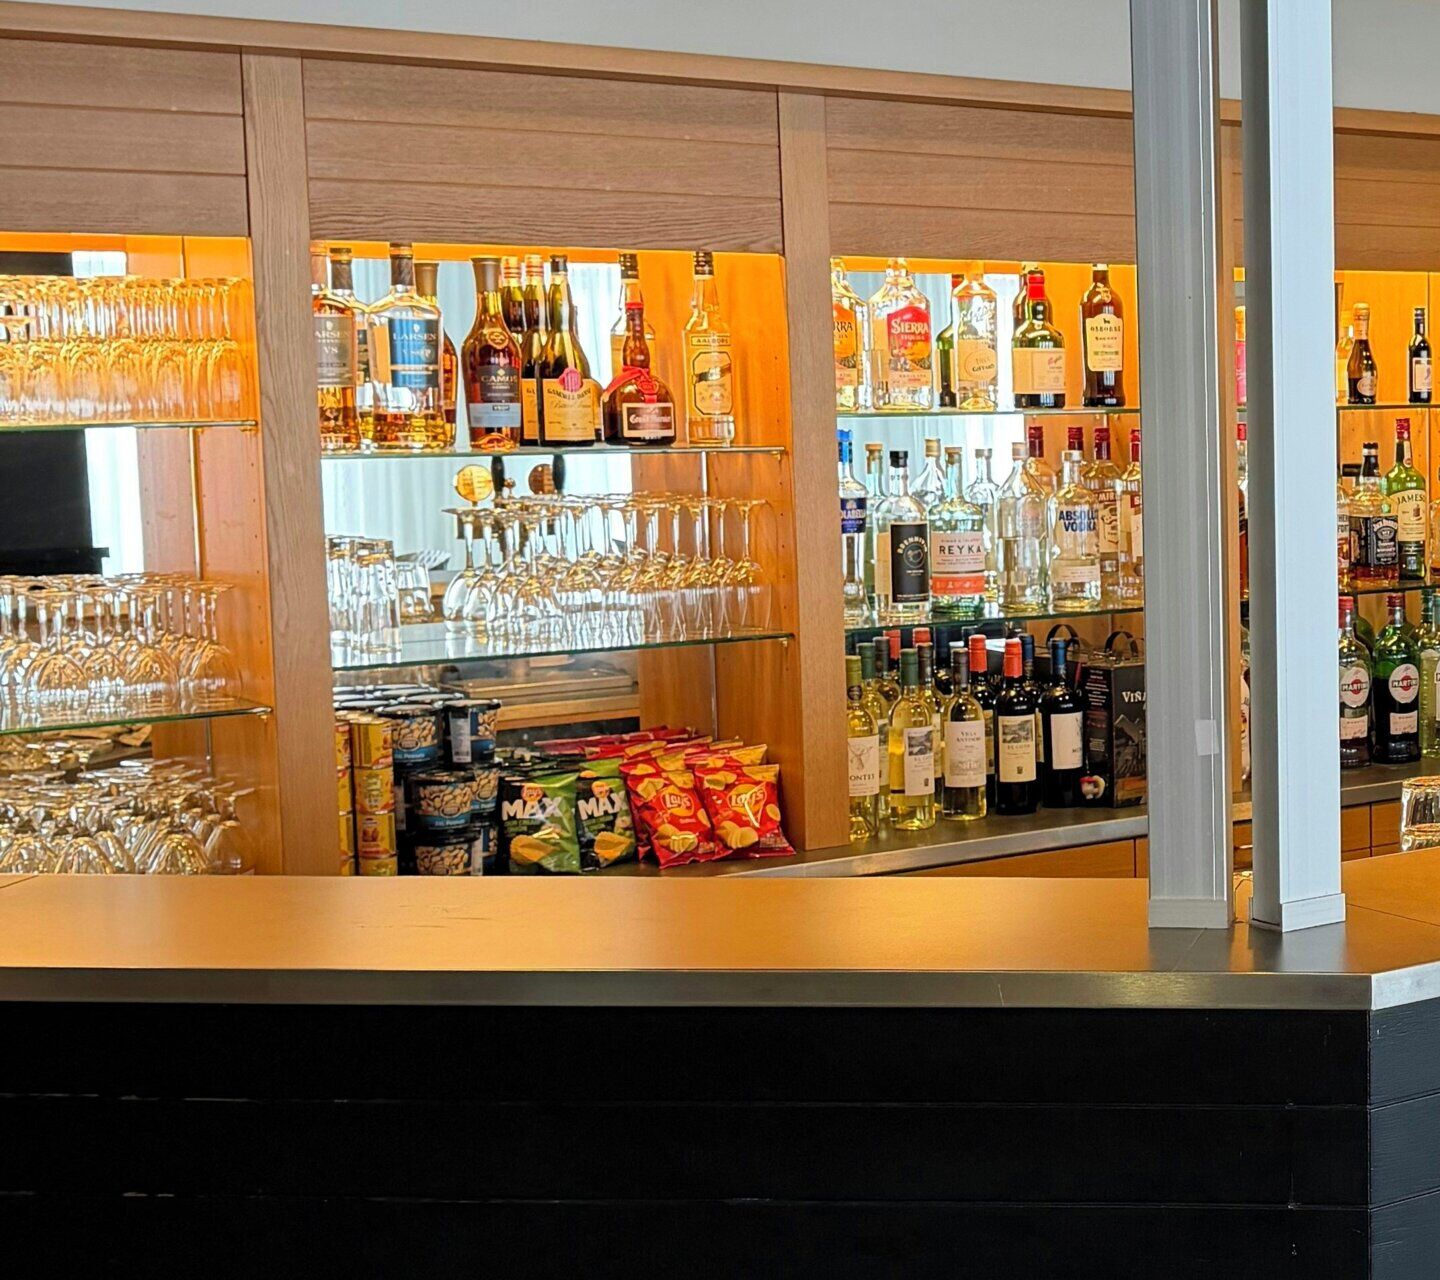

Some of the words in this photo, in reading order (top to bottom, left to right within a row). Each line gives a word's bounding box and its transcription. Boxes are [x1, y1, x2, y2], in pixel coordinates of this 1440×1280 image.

[891, 319, 929, 334] SIERRA
[393, 332, 437, 340] LARSEN
[480, 374, 518, 383] CAMUS
[1063, 521, 1097, 532] VODKA
[939, 545, 982, 555] REYKA
[502, 797, 562, 820] MAX
[578, 790, 626, 820] MAX
